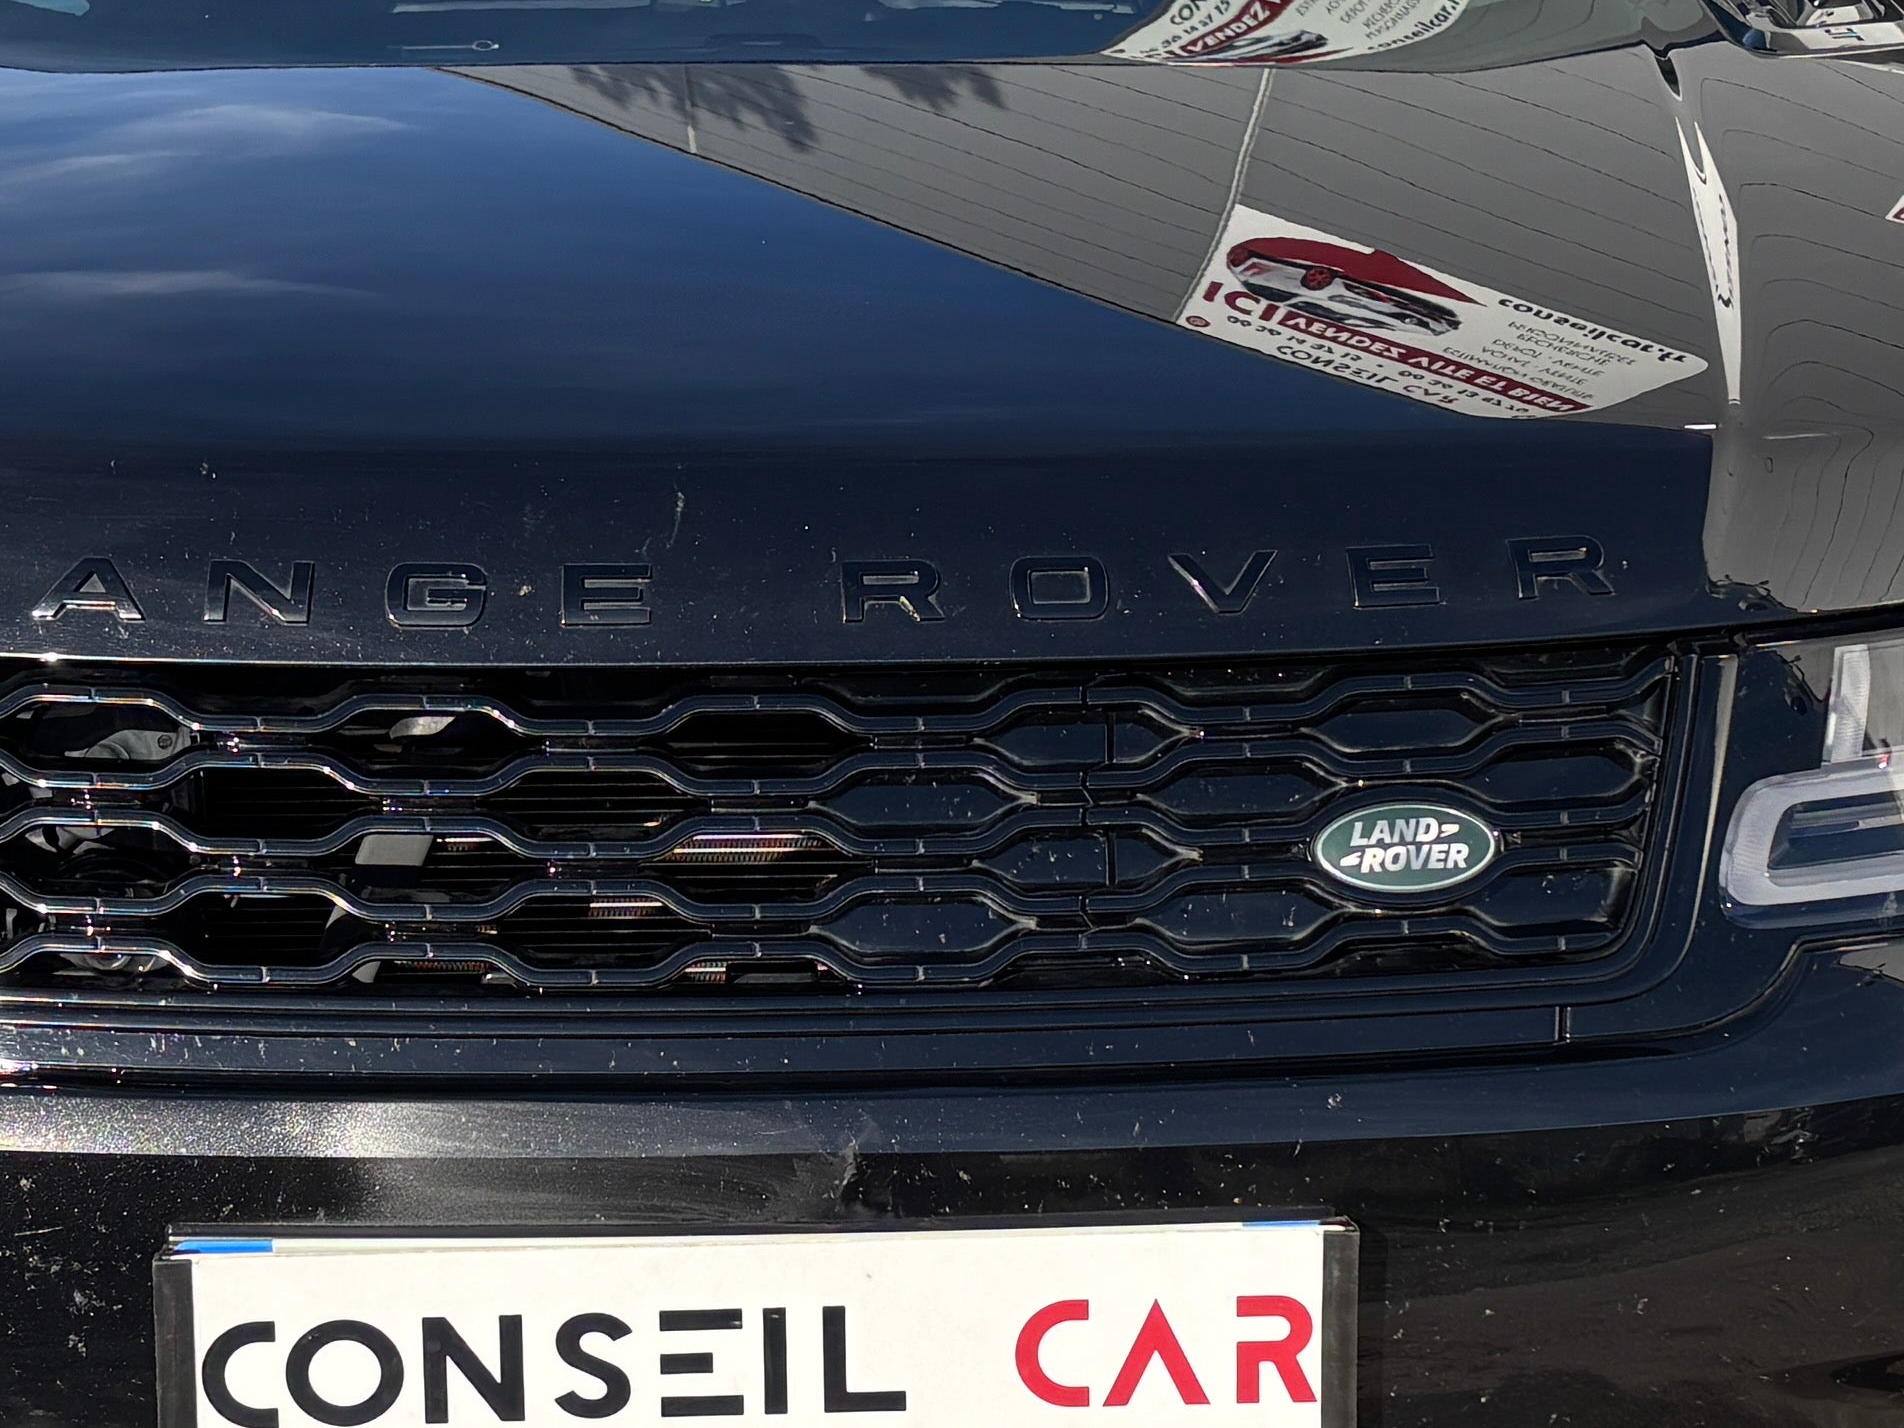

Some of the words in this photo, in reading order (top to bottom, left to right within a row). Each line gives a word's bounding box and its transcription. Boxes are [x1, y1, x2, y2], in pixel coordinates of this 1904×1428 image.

[1185, 1, 1270, 55] VENDEZ
[840, 535, 1617, 624] ROVER
[1350, 817, 1439, 847] LAND
[1360, 842, 1469, 873] ROVER
[1014, 1294, 1317, 1407] CAR
